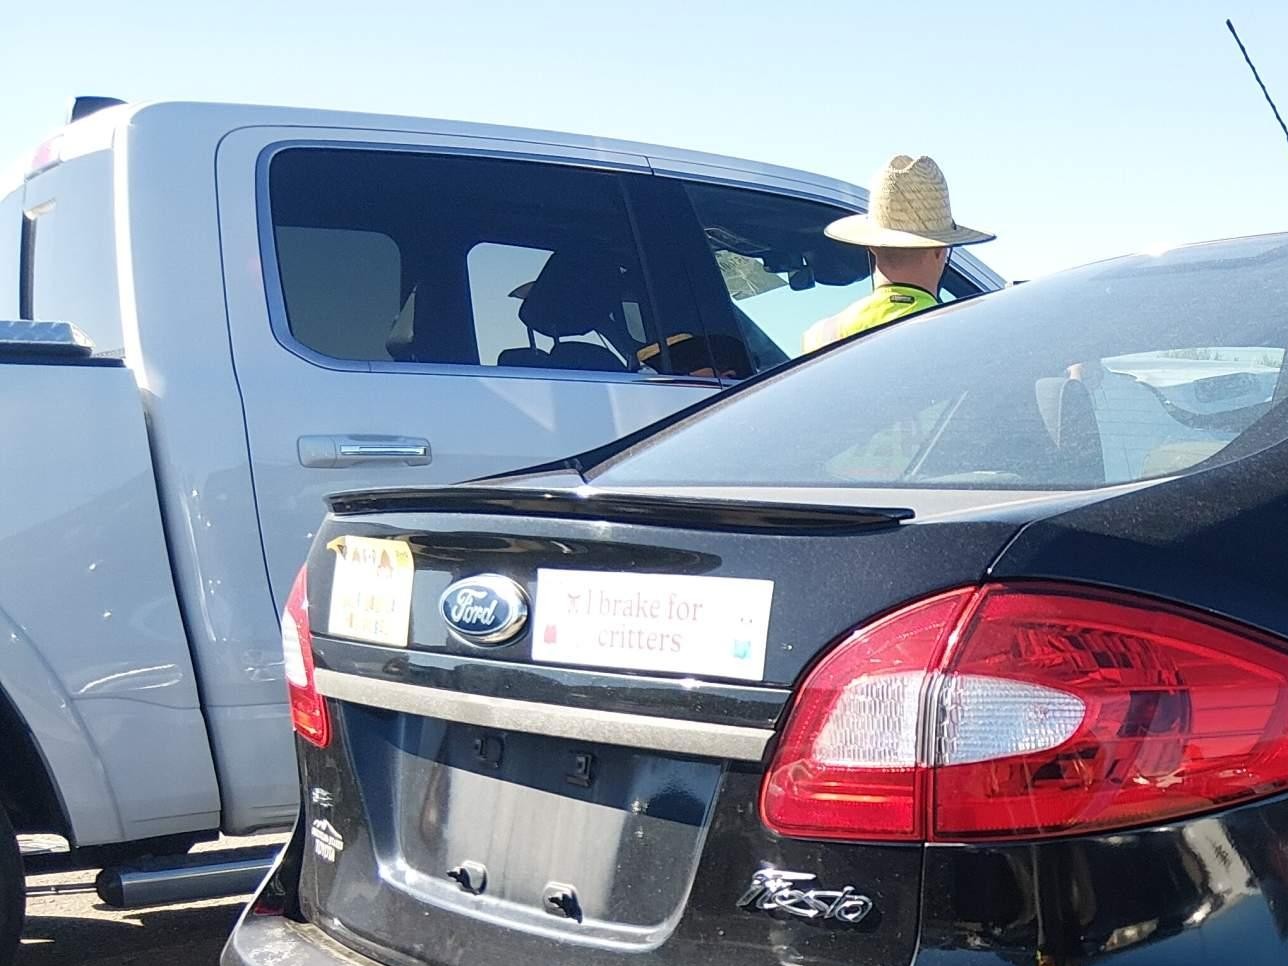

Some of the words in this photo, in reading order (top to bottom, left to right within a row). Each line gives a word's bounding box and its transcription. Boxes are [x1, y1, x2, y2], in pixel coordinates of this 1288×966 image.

[451, 588, 498, 625] Ford
[599, 590, 661, 619] brake
[668, 593, 703, 622] for
[597, 624, 682, 653] critters
[736, 867, 873, 923] Fiesta
